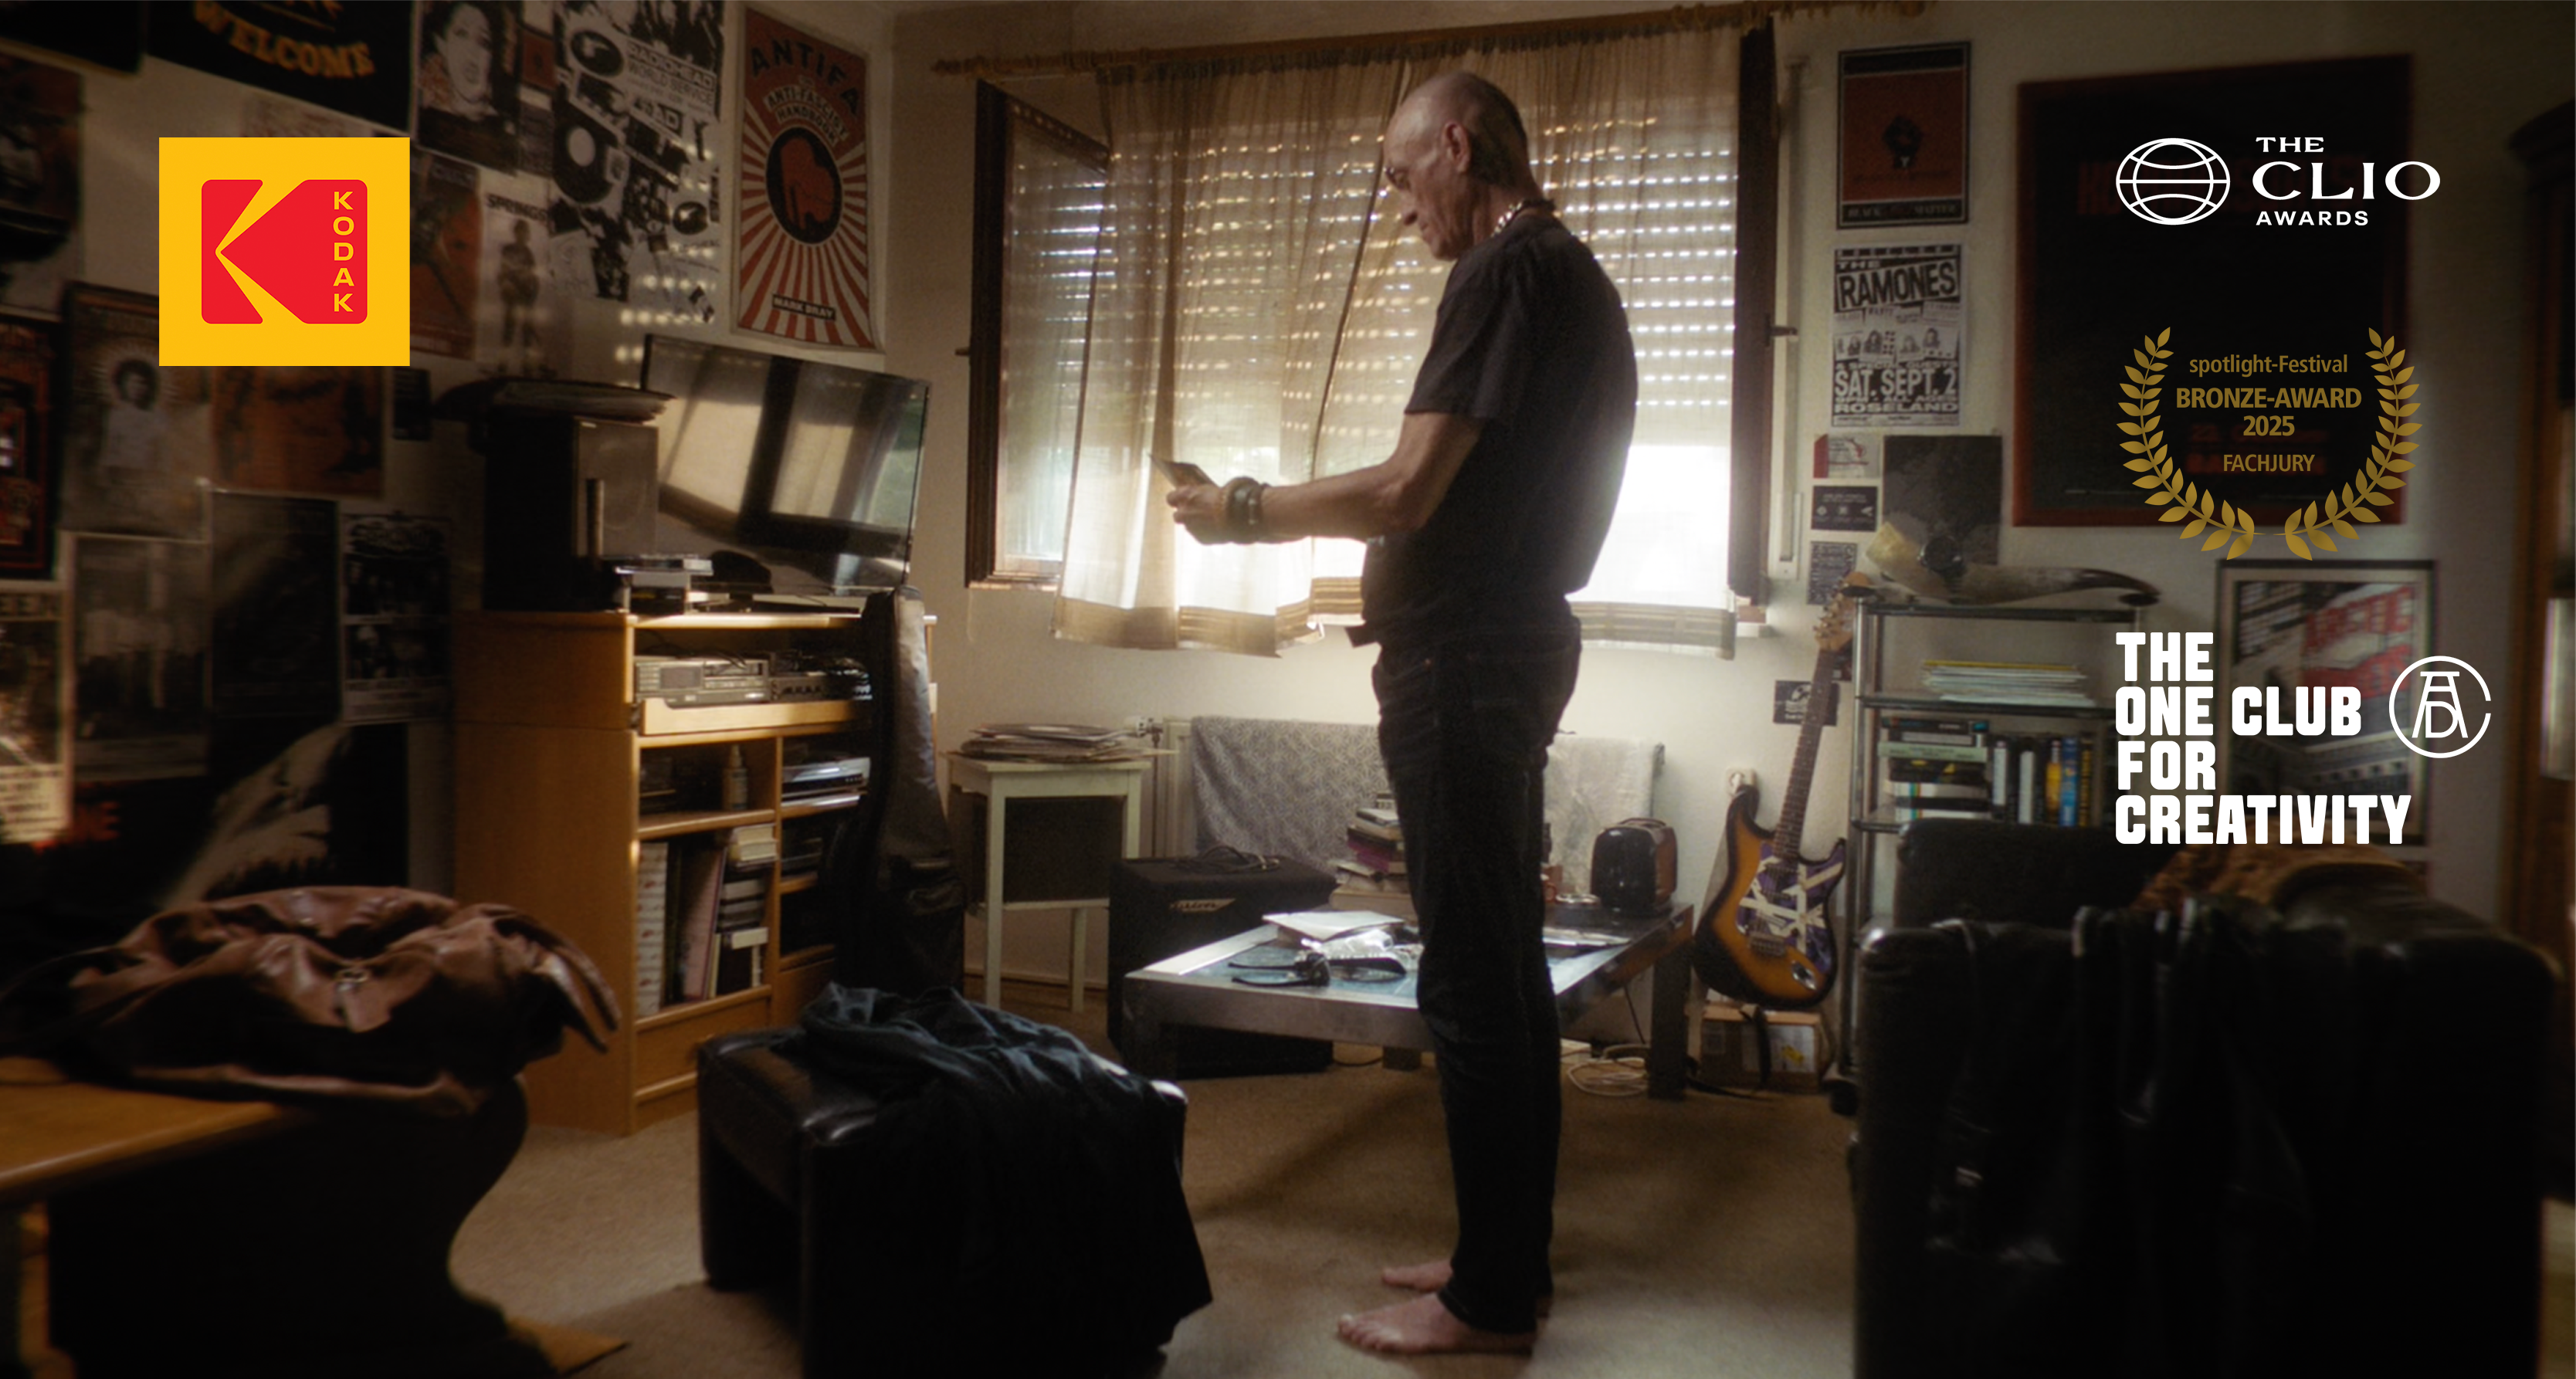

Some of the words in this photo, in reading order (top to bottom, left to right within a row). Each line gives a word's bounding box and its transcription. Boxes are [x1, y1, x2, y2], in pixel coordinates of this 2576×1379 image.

[192, 0, 376, 79] WELCOME
[628, 42, 713, 90] RADIOHEAD
[751, 39, 859, 115] ANTIFA
[1837, 259, 1881, 270] THE
[1839, 261, 1956, 309] RAMONES
[1834, 370, 1877, 398] SAT.
[1879, 368, 1939, 397] SEPT.
[1943, 369, 1957, 395] 2
[1834, 403, 1958, 413] ROSELAND
